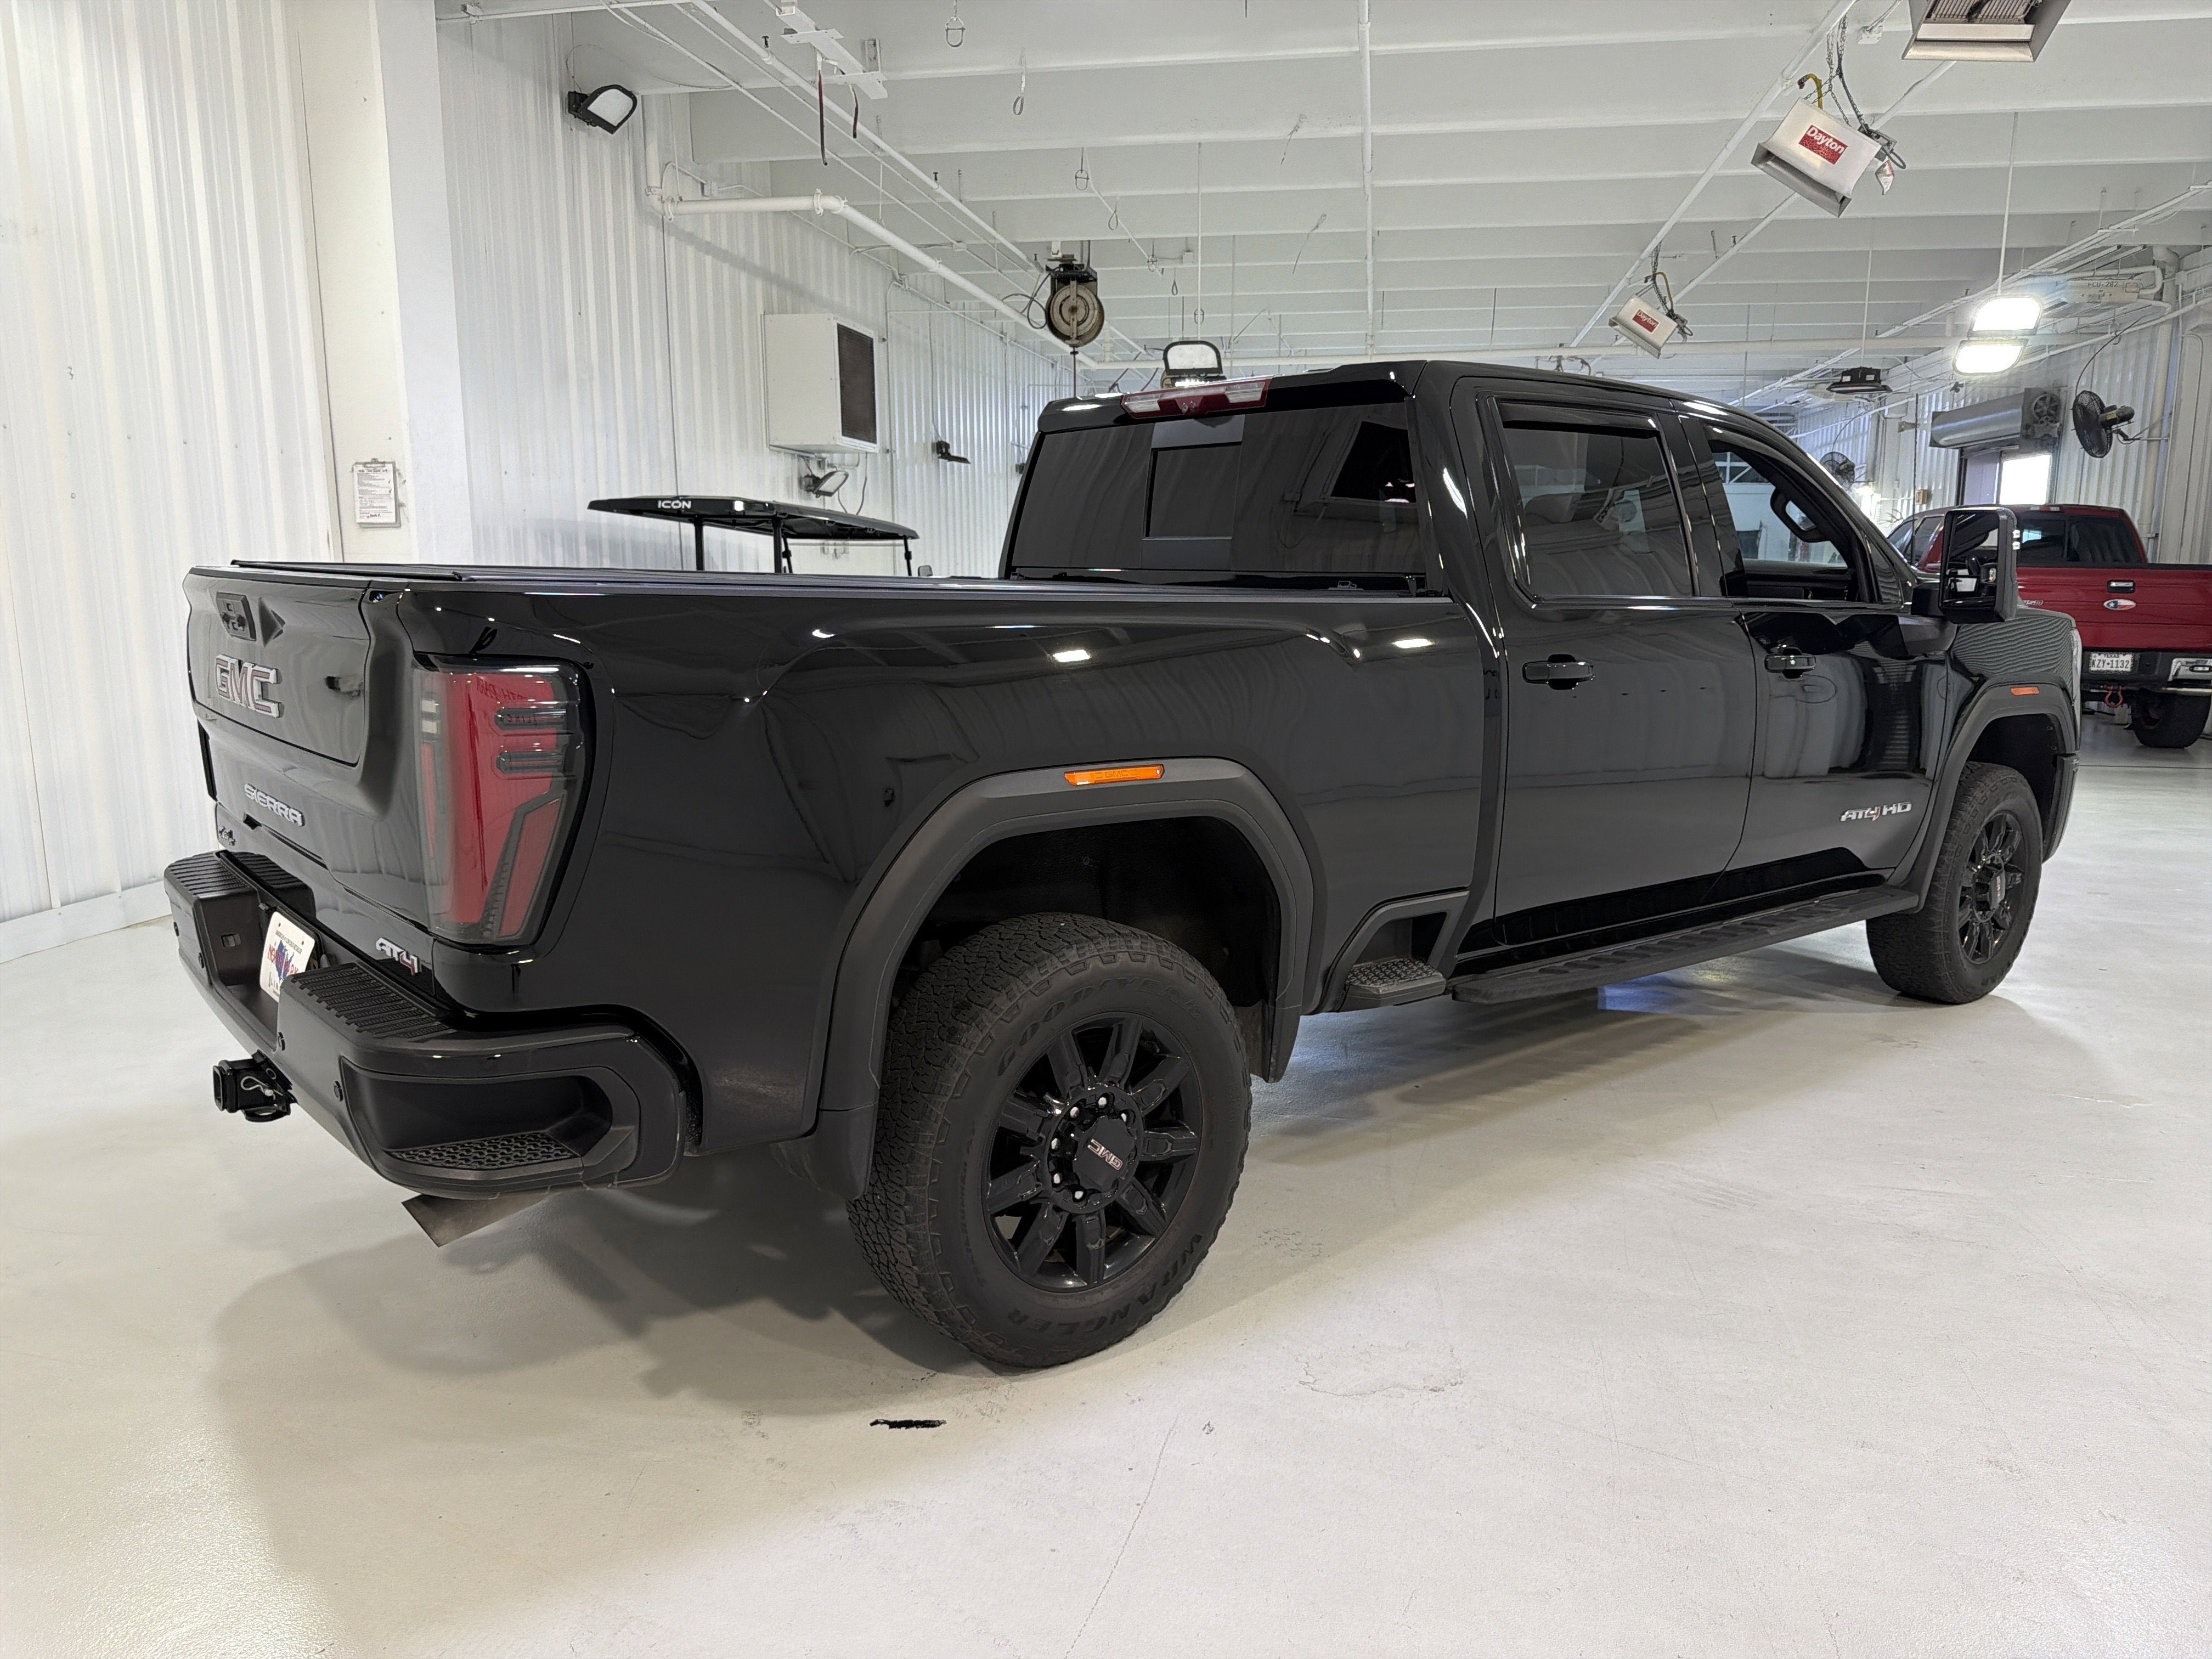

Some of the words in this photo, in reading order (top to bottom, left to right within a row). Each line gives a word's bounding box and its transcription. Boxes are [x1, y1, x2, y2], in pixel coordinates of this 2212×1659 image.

[1807, 126, 1845, 154] Dayton
[1636, 311, 1660, 328] Dayton
[658, 500, 691, 509] ICON
[215, 653, 281, 718] GMC
[1105, 770, 1128, 778] GMC
[244, 783, 305, 827] SIERRA
[1840, 806, 1881, 822] AT4
[1882, 802, 1912, 816] HD
[376, 937, 421, 976] AT4
[1088, 1138, 1123, 1171] GMC
[1007, 1231, 1204, 1335] WRANGLER
